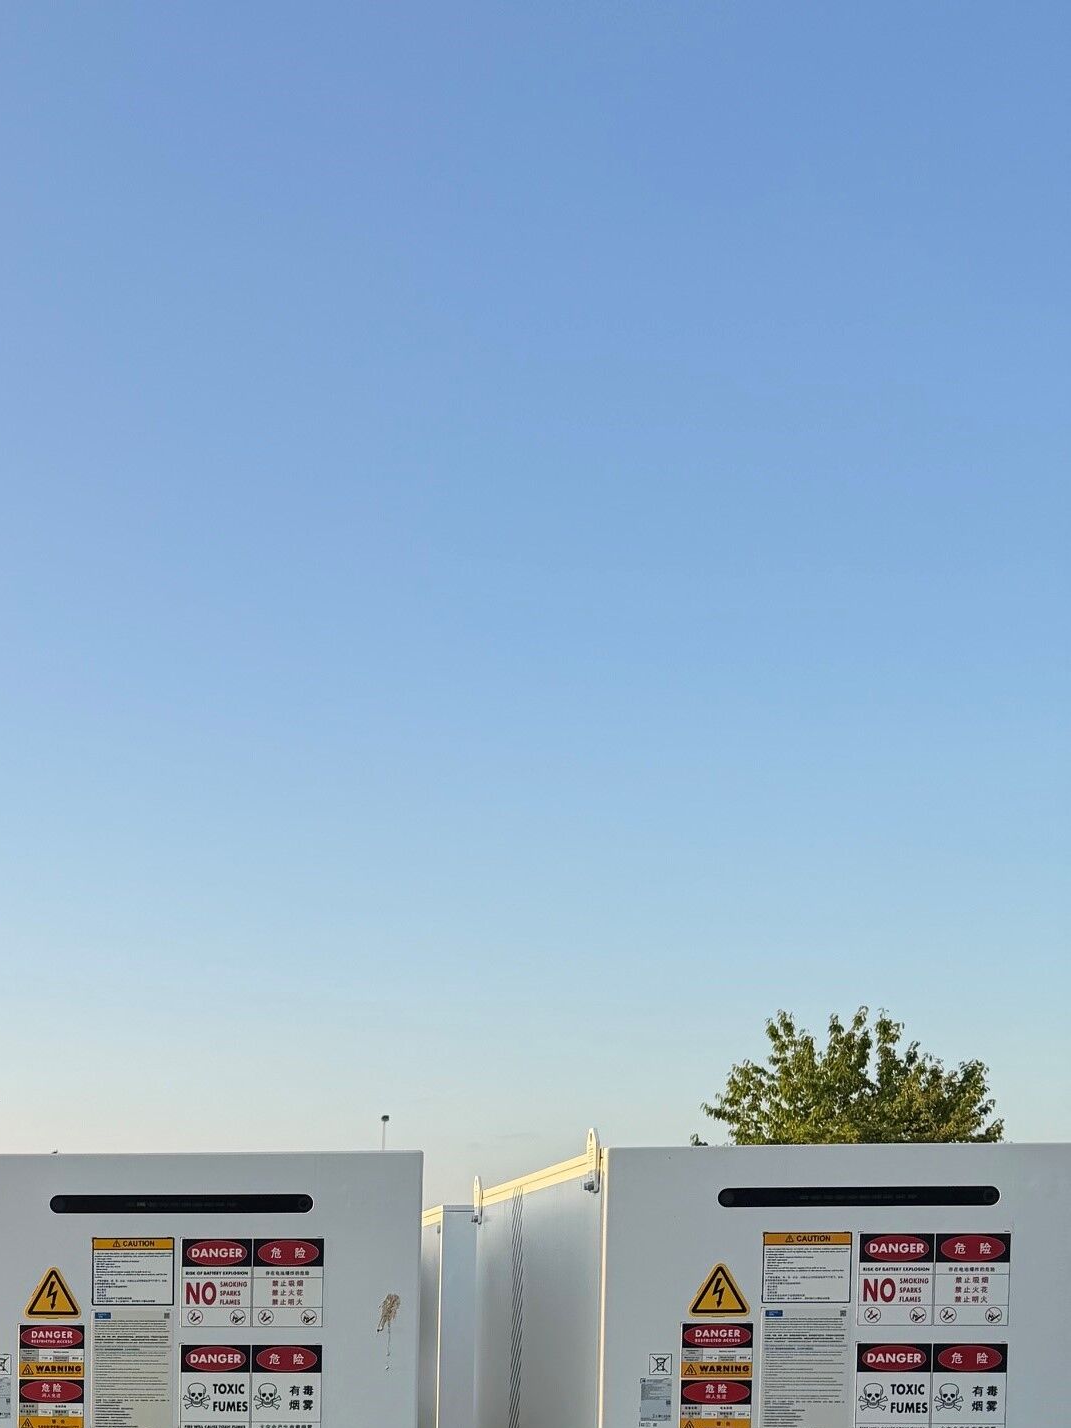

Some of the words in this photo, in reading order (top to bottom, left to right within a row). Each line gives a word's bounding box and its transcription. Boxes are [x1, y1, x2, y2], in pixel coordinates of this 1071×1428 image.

[191, 1248, 243, 1258] DANGER
[270, 1247, 306, 1259] 危险
[869, 1243, 925, 1254] DANGER
[954, 1242, 992, 1255] 危险
[186, 1281, 217, 1305] NO
[863, 1277, 896, 1303] NO
[31, 1330, 73, 1339] DANGER
[695, 1329, 741, 1338] DANGER
[190, 1353, 242, 1364] DANGER
[269, 1353, 304, 1365] 危险
[867, 1353, 922, 1363] DANGER
[951, 1351, 989, 1364] 危险
[699, 1365, 750, 1373] WARNING
[212, 1383, 245, 1395] TOXIC
[890, 1383, 925, 1396] TOXIC
[212, 1401, 248, 1412] FUMES
[890, 1402, 928, 1414] FUMES
